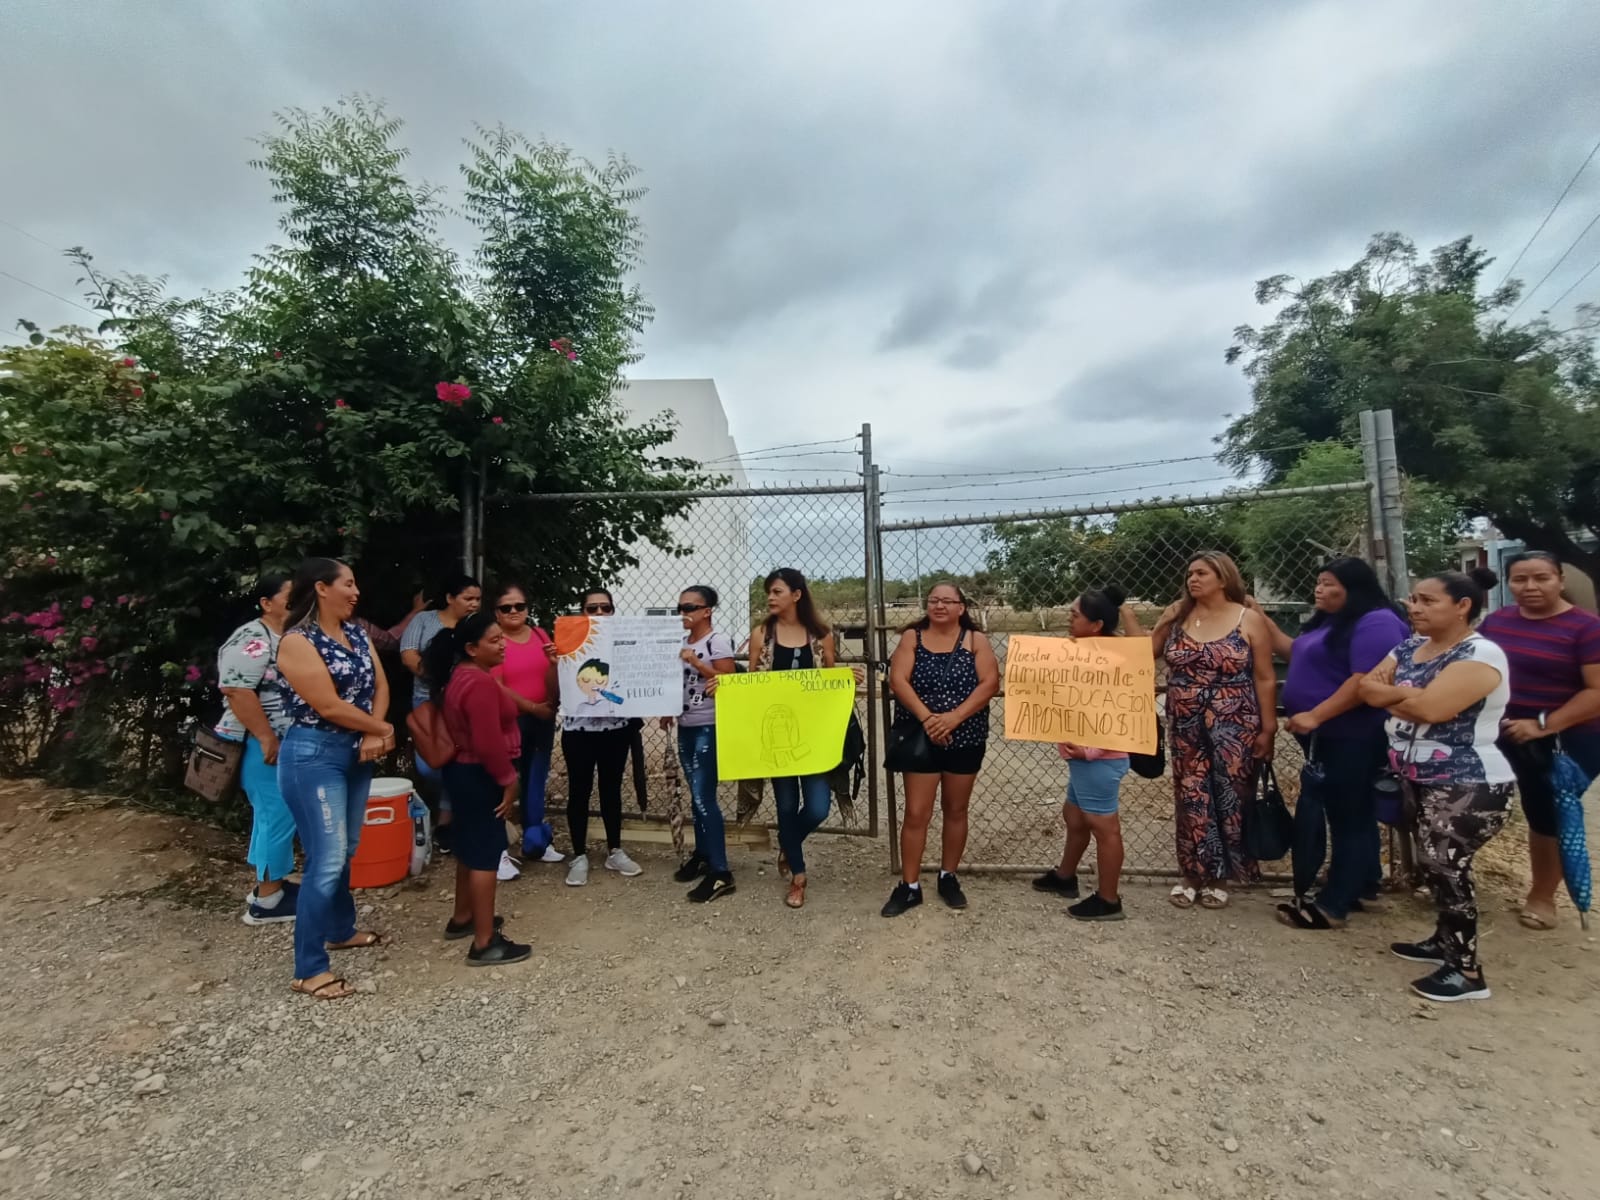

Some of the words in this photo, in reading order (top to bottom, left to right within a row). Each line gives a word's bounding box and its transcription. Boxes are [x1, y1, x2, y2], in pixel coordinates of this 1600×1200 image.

[1008, 638, 1051, 663] Nuestra
[1057, 642, 1091, 664] Salud
[1095, 655, 1109, 665] es
[721, 672, 771, 687] EXIGIMOS
[779, 670, 822, 681] PRONTA
